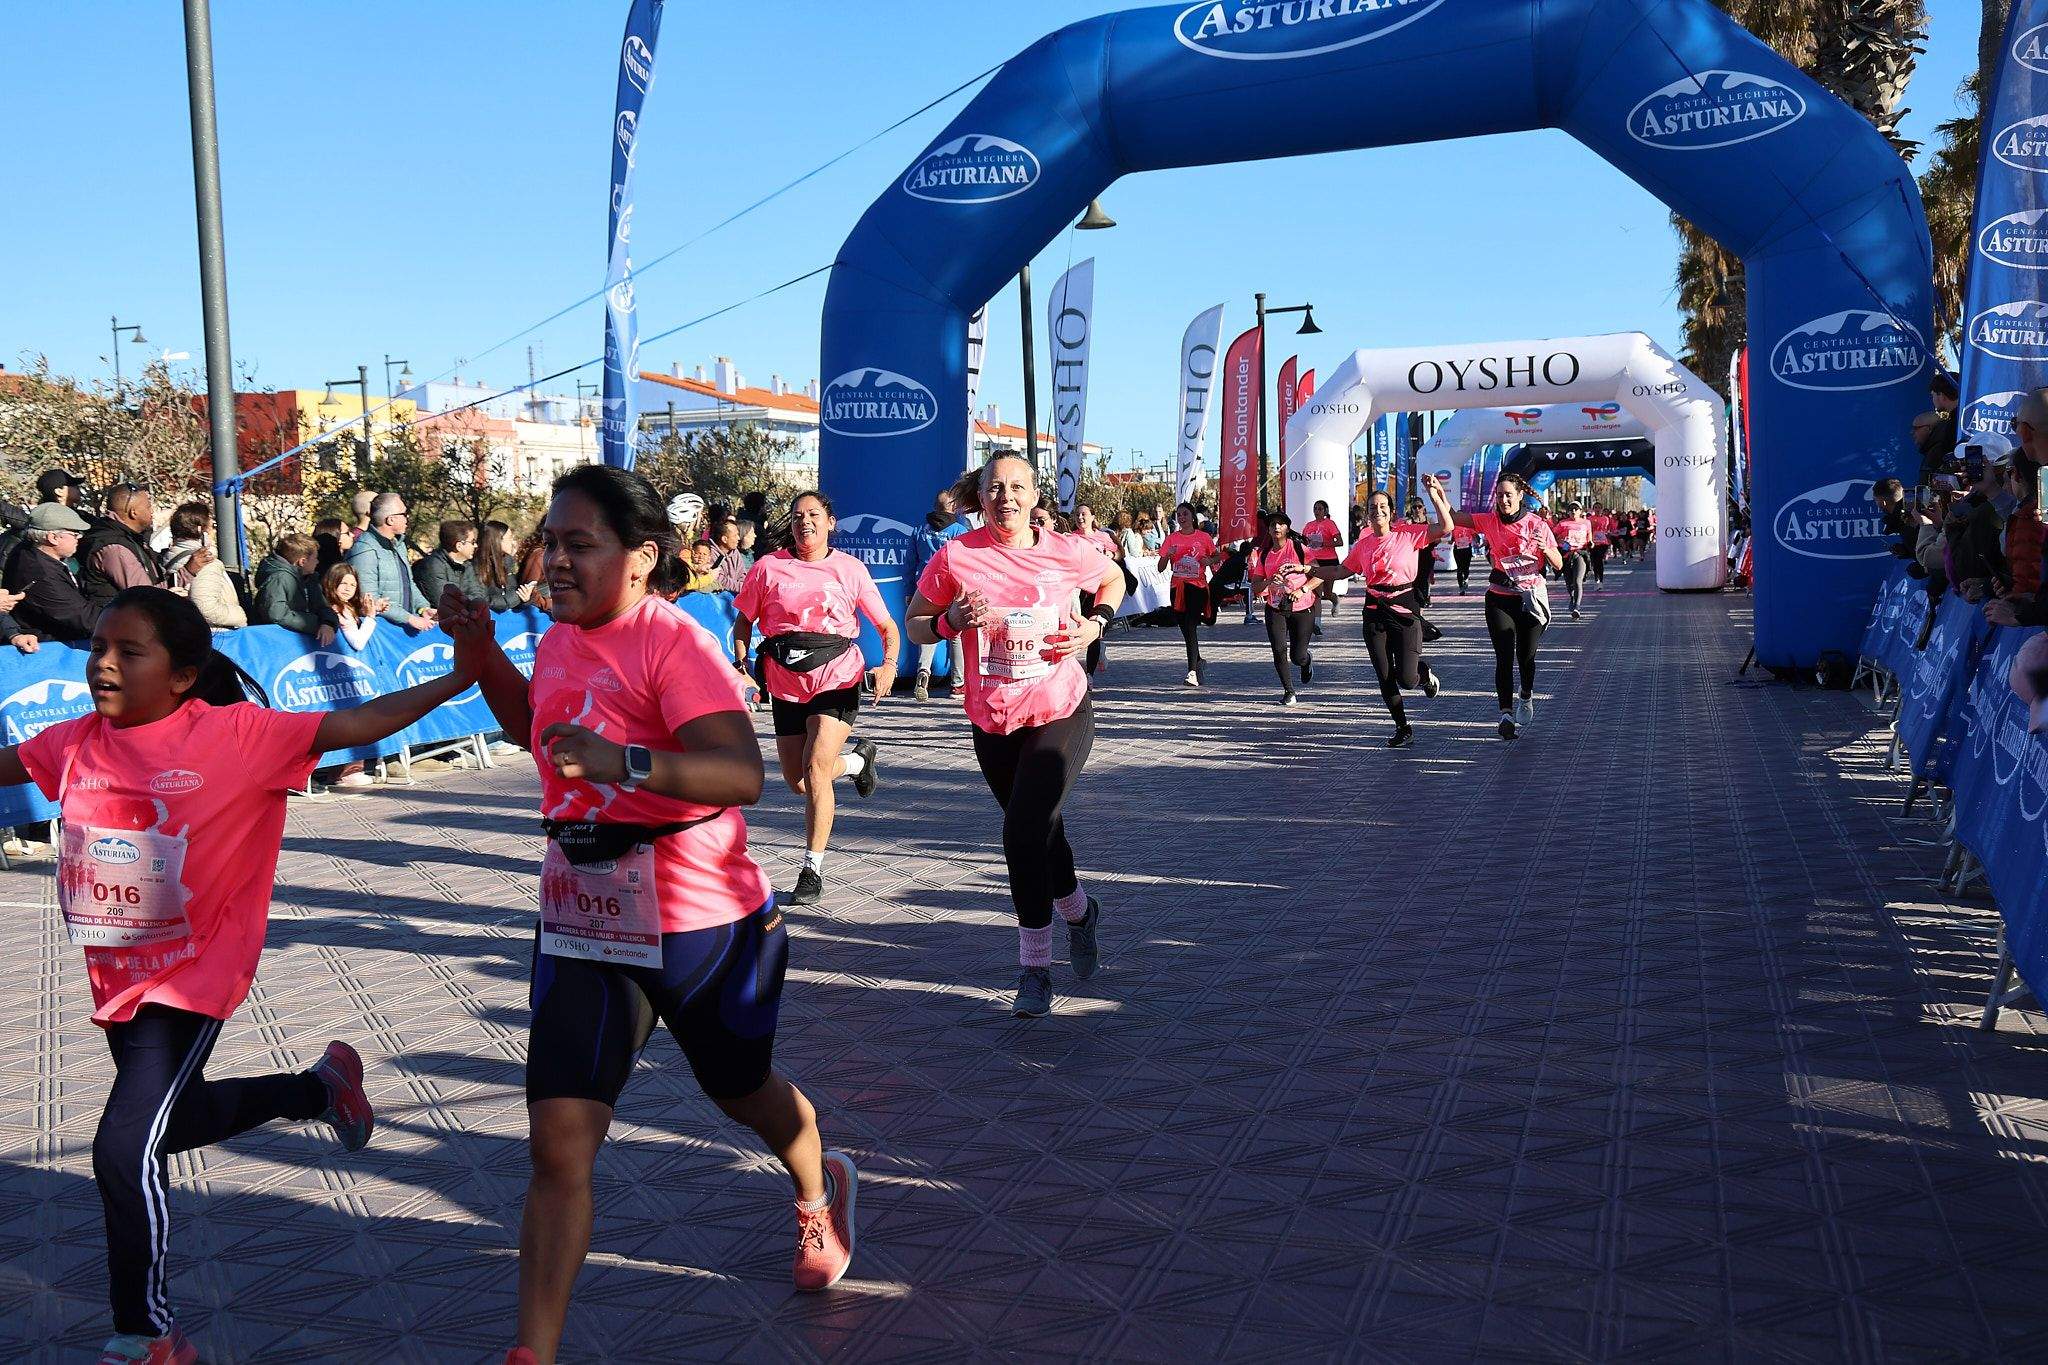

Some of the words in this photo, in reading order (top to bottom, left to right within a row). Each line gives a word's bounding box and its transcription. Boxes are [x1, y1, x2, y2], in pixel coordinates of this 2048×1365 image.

[1729, 90, 1785, 101] LECHERA
[1641, 100, 1795, 137] ASTURIANA
[932, 155, 972, 167] CENTRAL
[977, 154, 1024, 163] LECHERA
[910, 164, 1029, 189] ASTURIANA
[1985, 228, 2048, 253] ASTUR
[1993, 319, 2034, 327] CENTRAL
[1975, 319, 2048, 346] ASTURI
[1804, 337, 1861, 350] CENTRAL
[1780, 345, 1919, 375] ASTURIANA
[1408, 352, 1580, 394] OYSHO
[836, 391, 874, 399] CENTRAL
[879, 391, 925, 400] LECHERA
[1632, 383, 1688, 397] OYSHO
[824, 395, 929, 420] ASTURIANA
[1234, 356, 1249, 446] Santander
[1310, 404, 1359, 415] OYSHO
[1982, 409, 2016, 418] CENTRA
[1376, 429, 1389, 484] Marlene
[1546, 449, 1632, 460] VOLVO
[1663, 454, 1716, 467] OYSHO
[1290, 470, 1334, 482] OYSHO
[1231, 474, 1250, 528] Sports
[1807, 507, 1863, 517] CENTRAL
[1664, 525, 1716, 538] OYSHO
[1784, 511, 1886, 541] ASTURI
[1006, 640, 1034, 651] 016
[286, 679, 376, 708] ASTURIANA
[21, 706, 69, 719] CENTRAL
[91, 846, 136, 859] ASTURIANA
[93, 883, 141, 904] 016
[577, 893, 621, 916] 016
[107, 907, 124, 916] 209
[132, 930, 174, 940] Santander
[596, 931, 618, 940] MUJER
[554, 938, 590, 952] OYSHO
[612, 947, 648, 959] Santander
